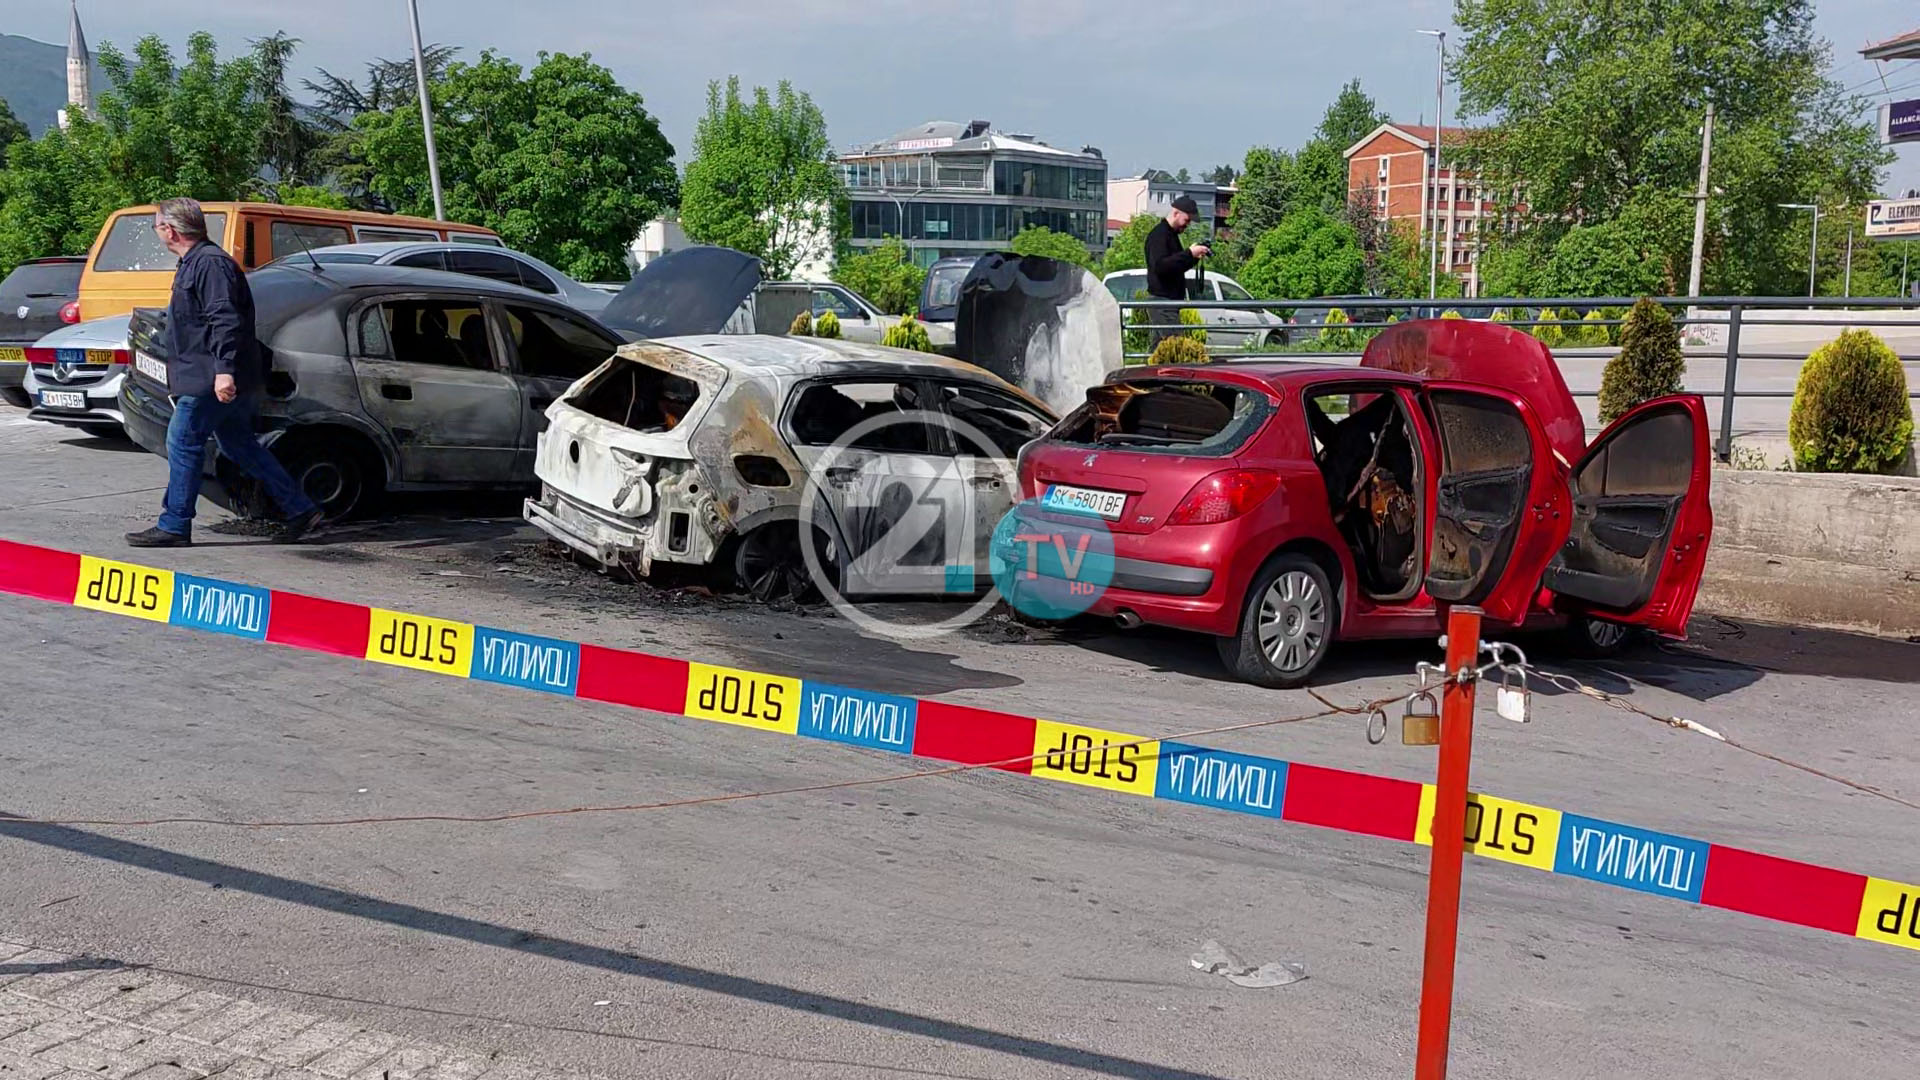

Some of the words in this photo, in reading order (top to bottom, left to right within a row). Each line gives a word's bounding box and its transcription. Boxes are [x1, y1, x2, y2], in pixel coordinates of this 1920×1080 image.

[89, 350, 112, 362] STOP
[87, 566, 160, 612] STOP
[379, 618, 458, 665] STOP
[698, 674, 783, 722] STOP
[1046, 732, 1140, 783] STOP
[1430, 801, 1537, 855] STO
